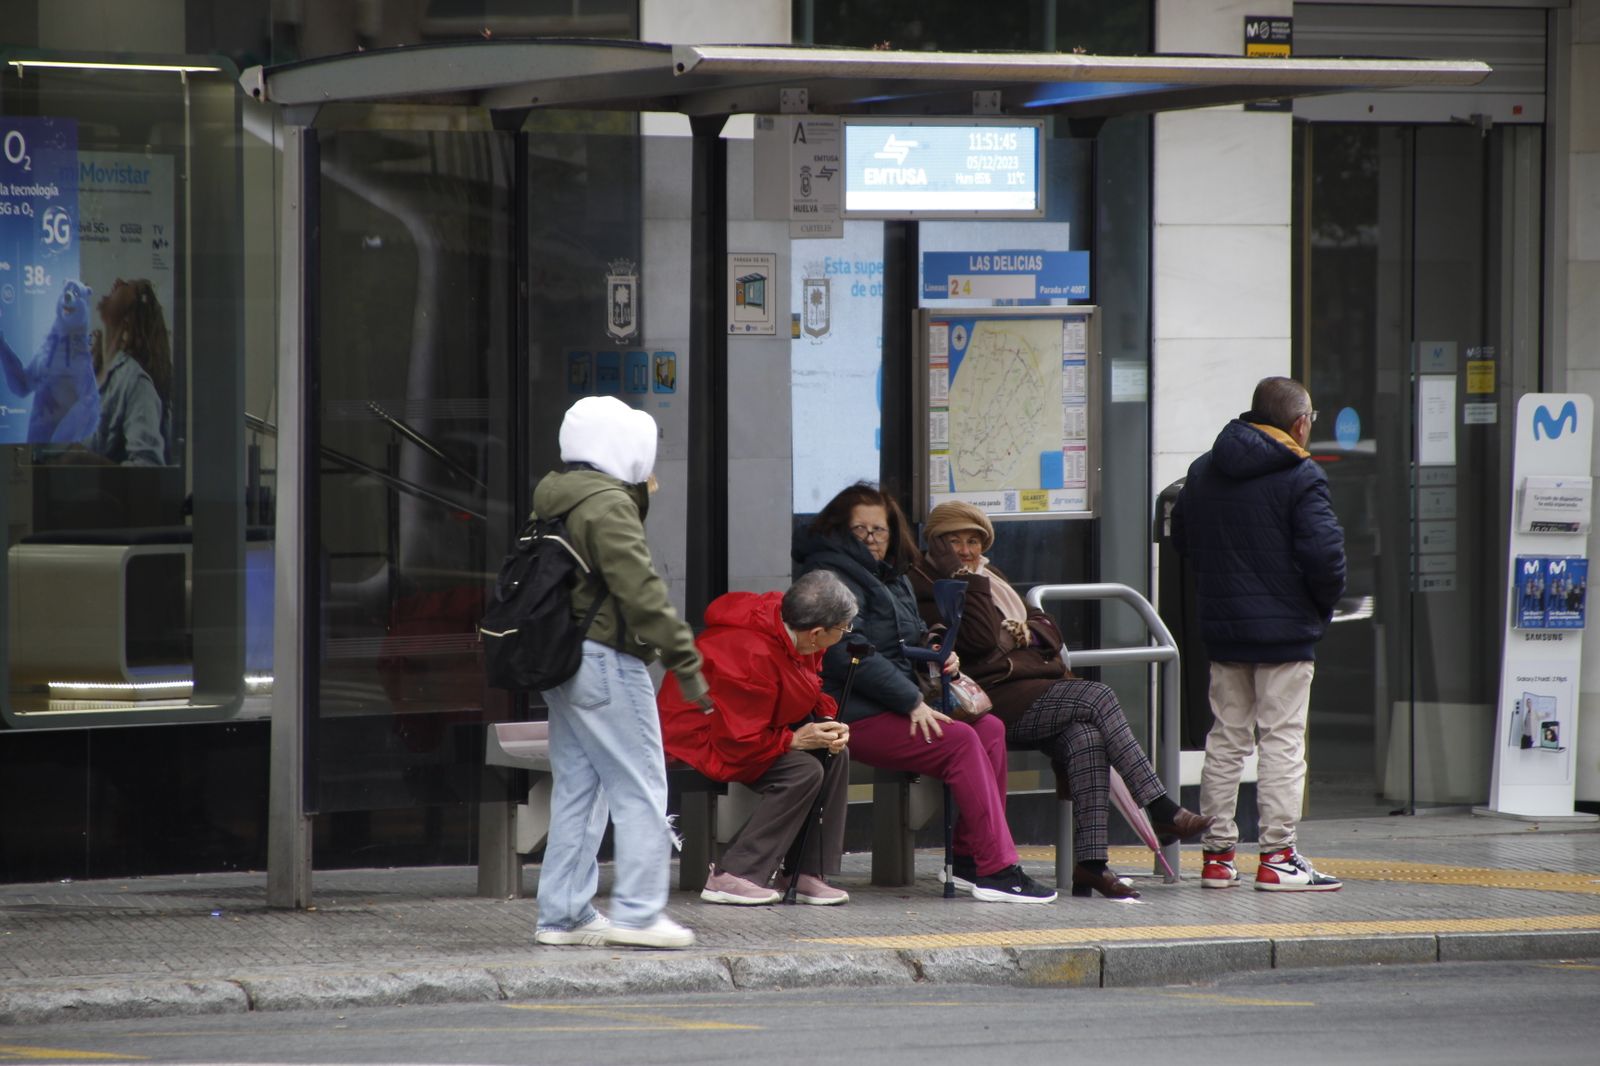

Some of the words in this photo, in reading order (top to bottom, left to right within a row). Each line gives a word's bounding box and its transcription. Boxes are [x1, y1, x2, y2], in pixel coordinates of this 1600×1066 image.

[968, 132, 1017, 150] 11:51:45
[966, 156, 1019, 170] 05/12/2023
[864, 168, 928, 185] EMTUSA
[0, 183, 9, 195] la
[10, 182, 59, 199] tecnología
[13, 205, 20, 215] a
[793, 204, 818, 213] HUELVA
[42, 213, 70, 245] 5G
[153, 224, 163, 235] TV
[824, 256, 852, 274] Esta
[969, 256, 991, 270] LAS
[993, 255, 1043, 271] DELICIAS
[851, 281, 866, 297] de
[951, 280, 959, 296] 2
[963, 280, 972, 295] 4
[1040, 285, 1062, 294] Parada
[1525, 633, 1564, 641] SAMSUNG
